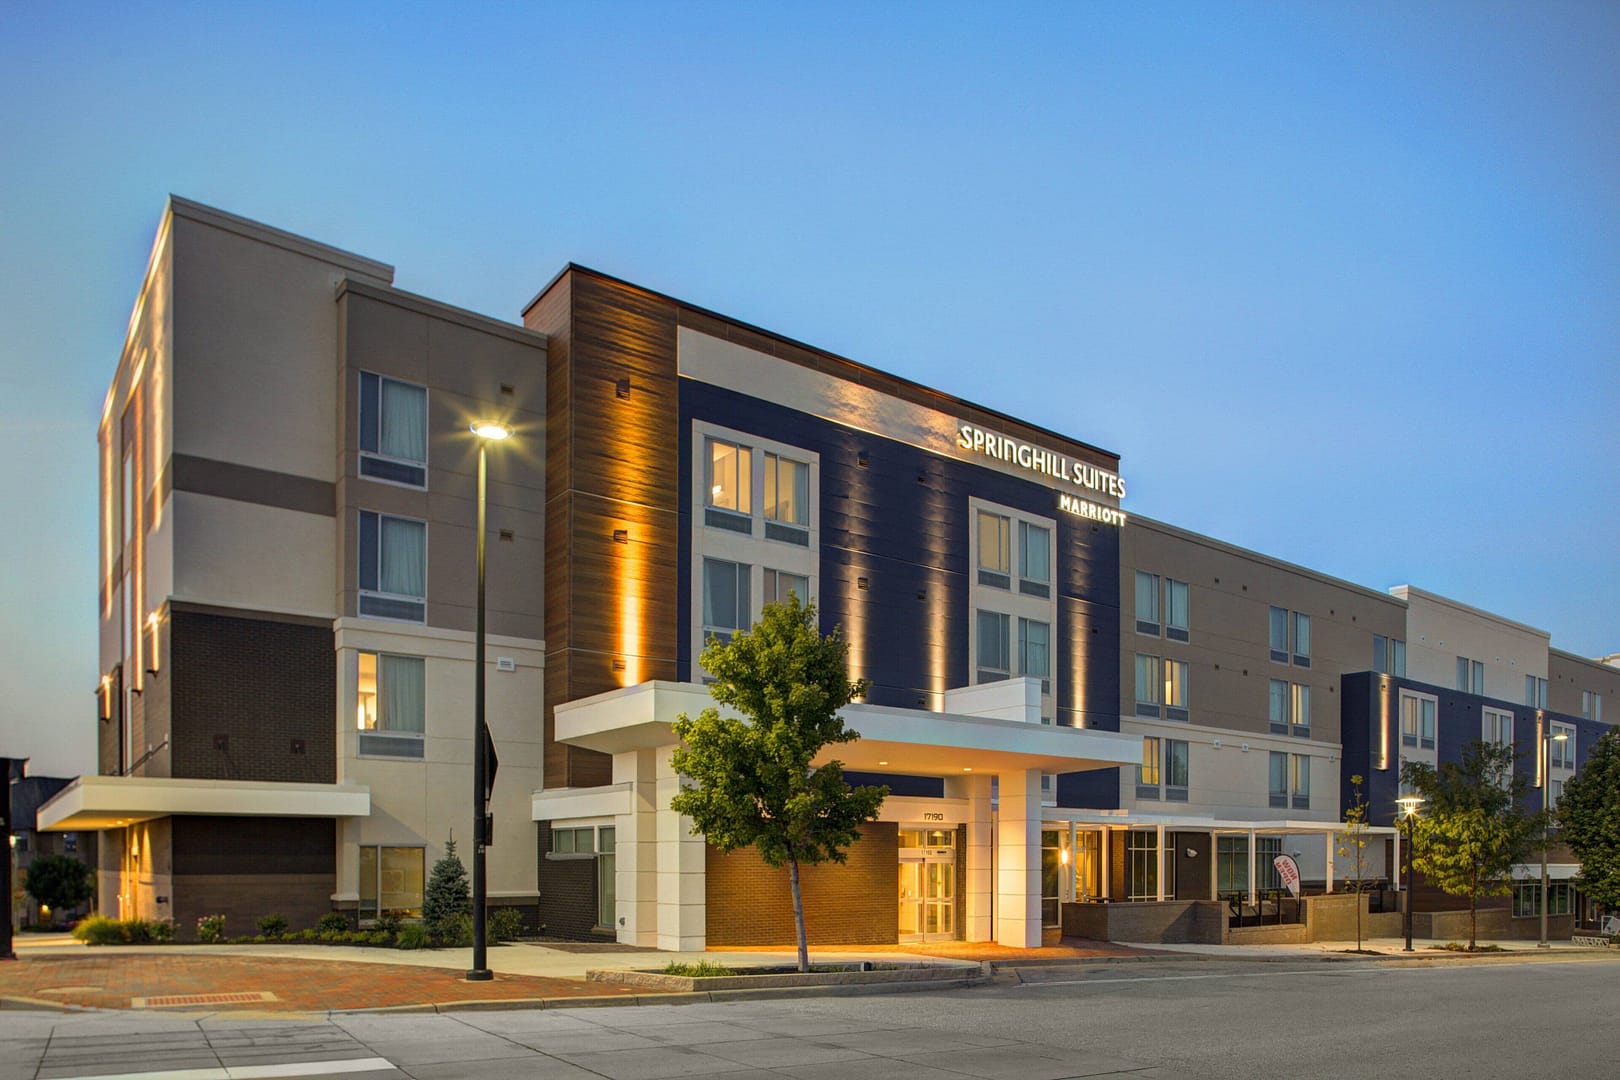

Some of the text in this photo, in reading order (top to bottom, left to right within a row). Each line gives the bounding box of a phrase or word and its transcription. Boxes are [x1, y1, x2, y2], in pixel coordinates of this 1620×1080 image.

[959, 425, 1126, 499] SPRINGHILL SUITES
[1060, 494, 1127, 527] MARRIOTT
[924, 812, 944, 821] 17190
